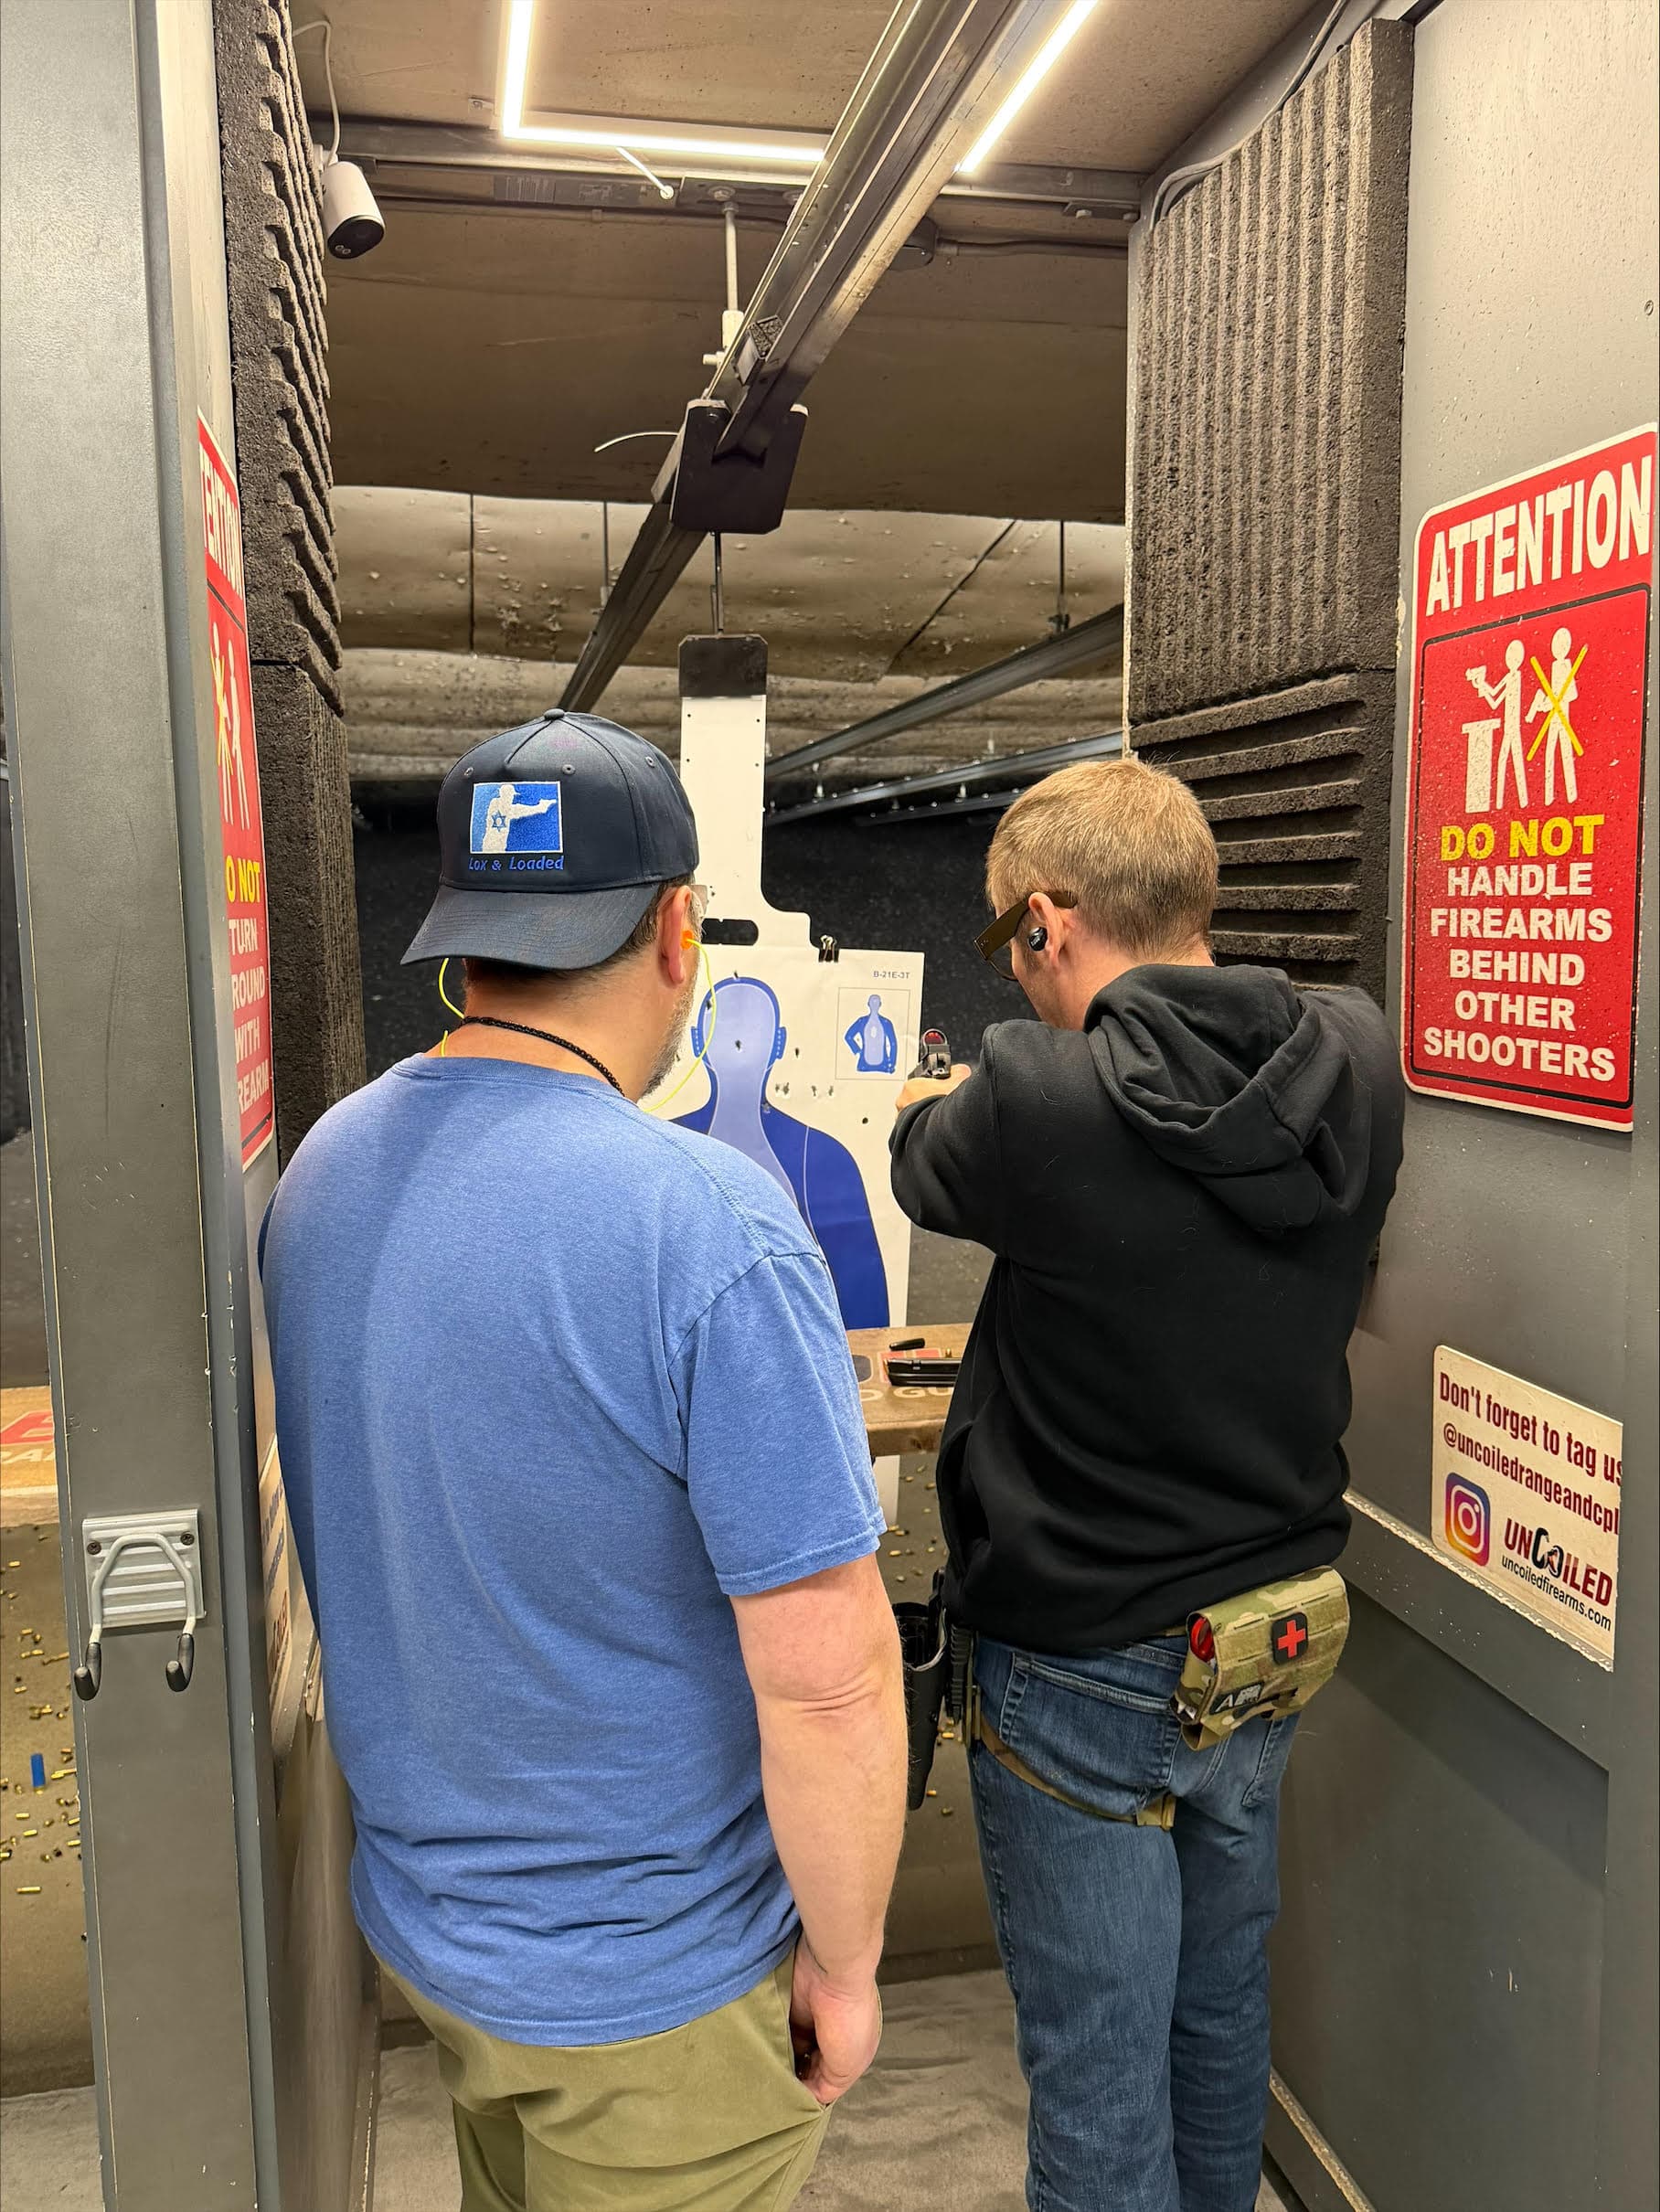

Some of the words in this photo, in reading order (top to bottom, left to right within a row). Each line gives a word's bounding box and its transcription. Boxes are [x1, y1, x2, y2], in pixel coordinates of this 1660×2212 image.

[199, 442, 243, 601] TENTION
[1426, 454, 1652, 616] ATTENTION
[1441, 823, 1495, 861] DO
[1509, 814, 1604, 858] NOT
[226, 855, 237, 903] O
[238, 857, 261, 903] NOT
[468, 857, 488, 871] Lox
[492, 859, 502, 871] &
[509, 855, 565, 871] Loaded
[1447, 862, 1593, 897] HANDLE
[229, 918, 258, 955] TURN
[1431, 907, 1612, 942] FIREARMS
[231, 966, 265, 1011] ROUND
[1449, 949, 1585, 985] BEHIND
[1454, 990, 1576, 1031] OTHER
[234, 1016, 261, 1064] WITH
[1423, 1026, 1615, 1082] SHOOTERS
[238, 1058, 270, 1114] REARM
[1440, 1372, 1481, 1419] Don't
[1485, 1394, 1538, 1447] forget
[1543, 1420, 1559, 1456] to
[1566, 1430, 1596, 1478] tag
[1443, 1422, 1619, 1536] @uncoiledrangeandcpl
[1505, 1517, 1612, 1608] UNCOILED
[1502, 1554, 1612, 1632] uncoiledfirearms.com
